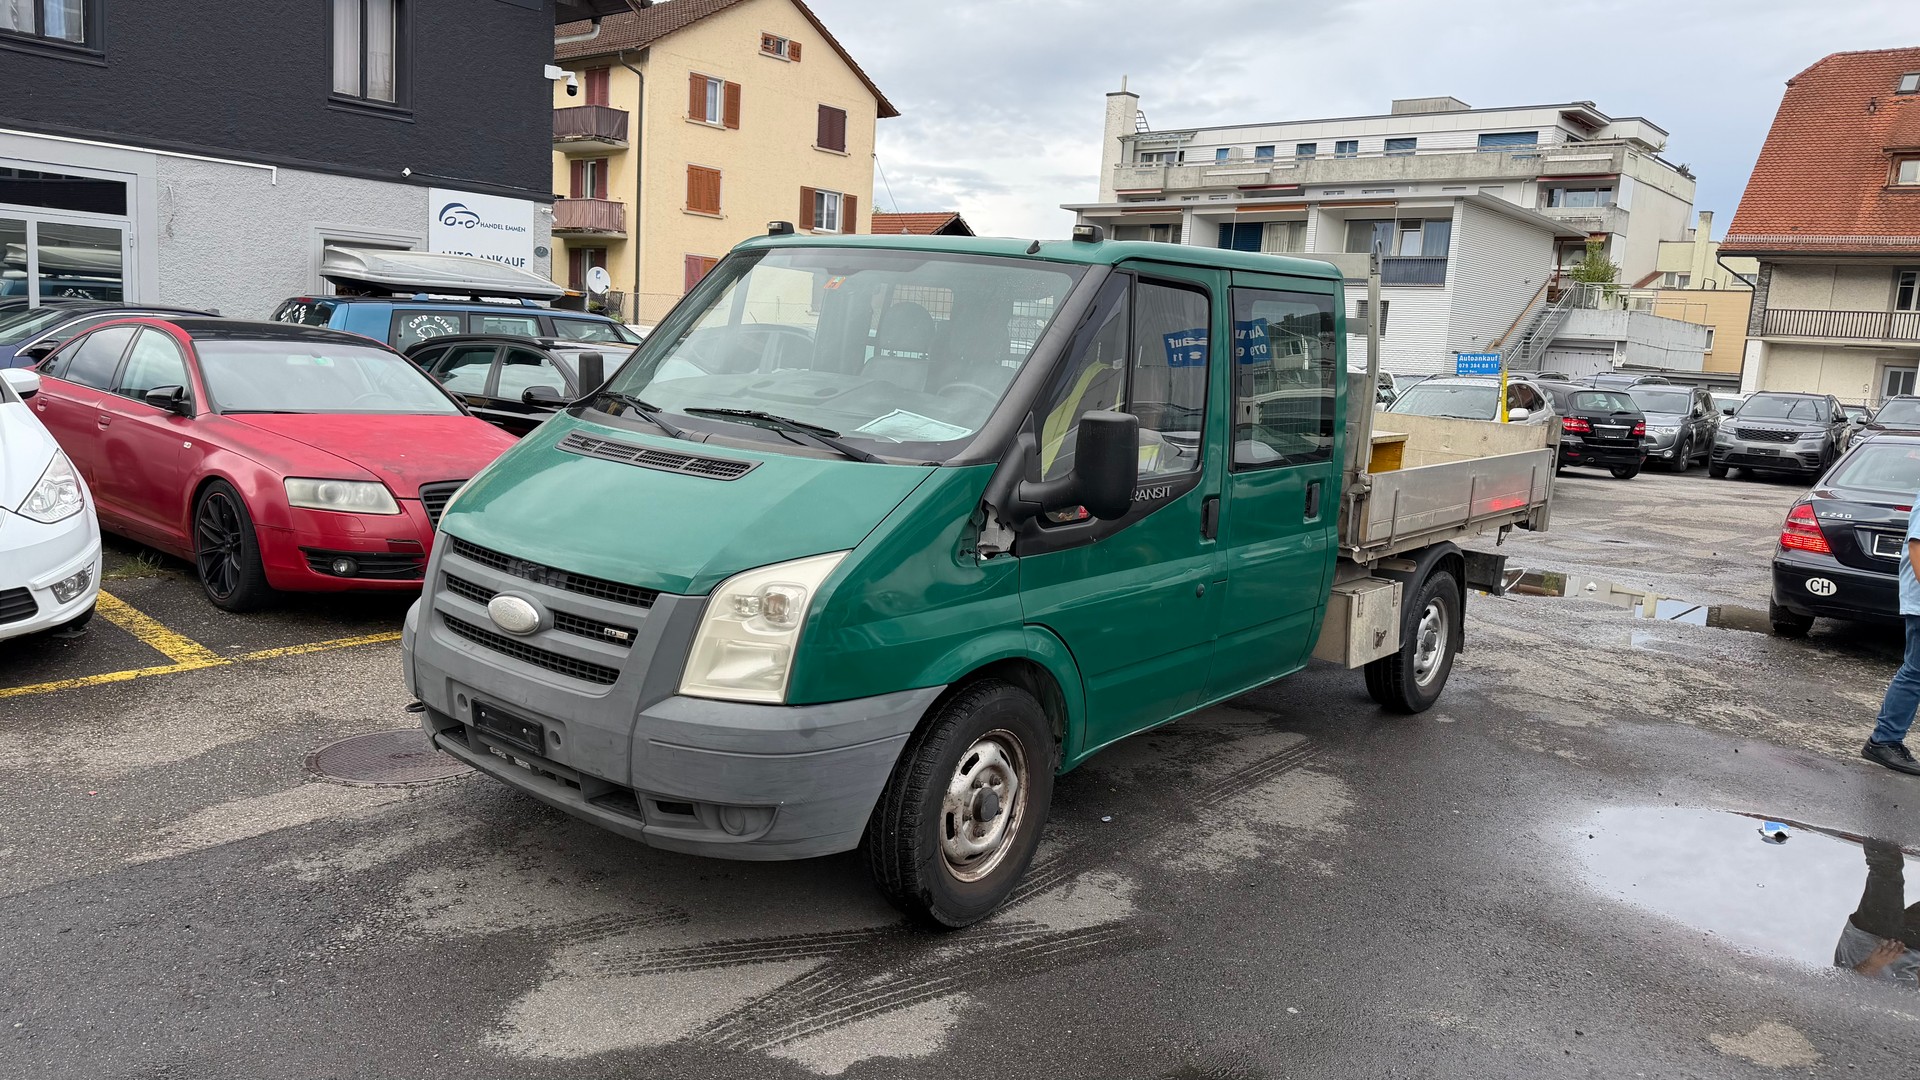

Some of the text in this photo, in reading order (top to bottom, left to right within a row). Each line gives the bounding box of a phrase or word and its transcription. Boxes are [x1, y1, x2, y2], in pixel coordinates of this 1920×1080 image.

[480, 221, 526, 233] HANDEL EMMEN
[409, 314, 454, 333] Carp Club
[1134, 485, 1172, 502] RANSIT
[1809, 579, 1831, 594] CH
